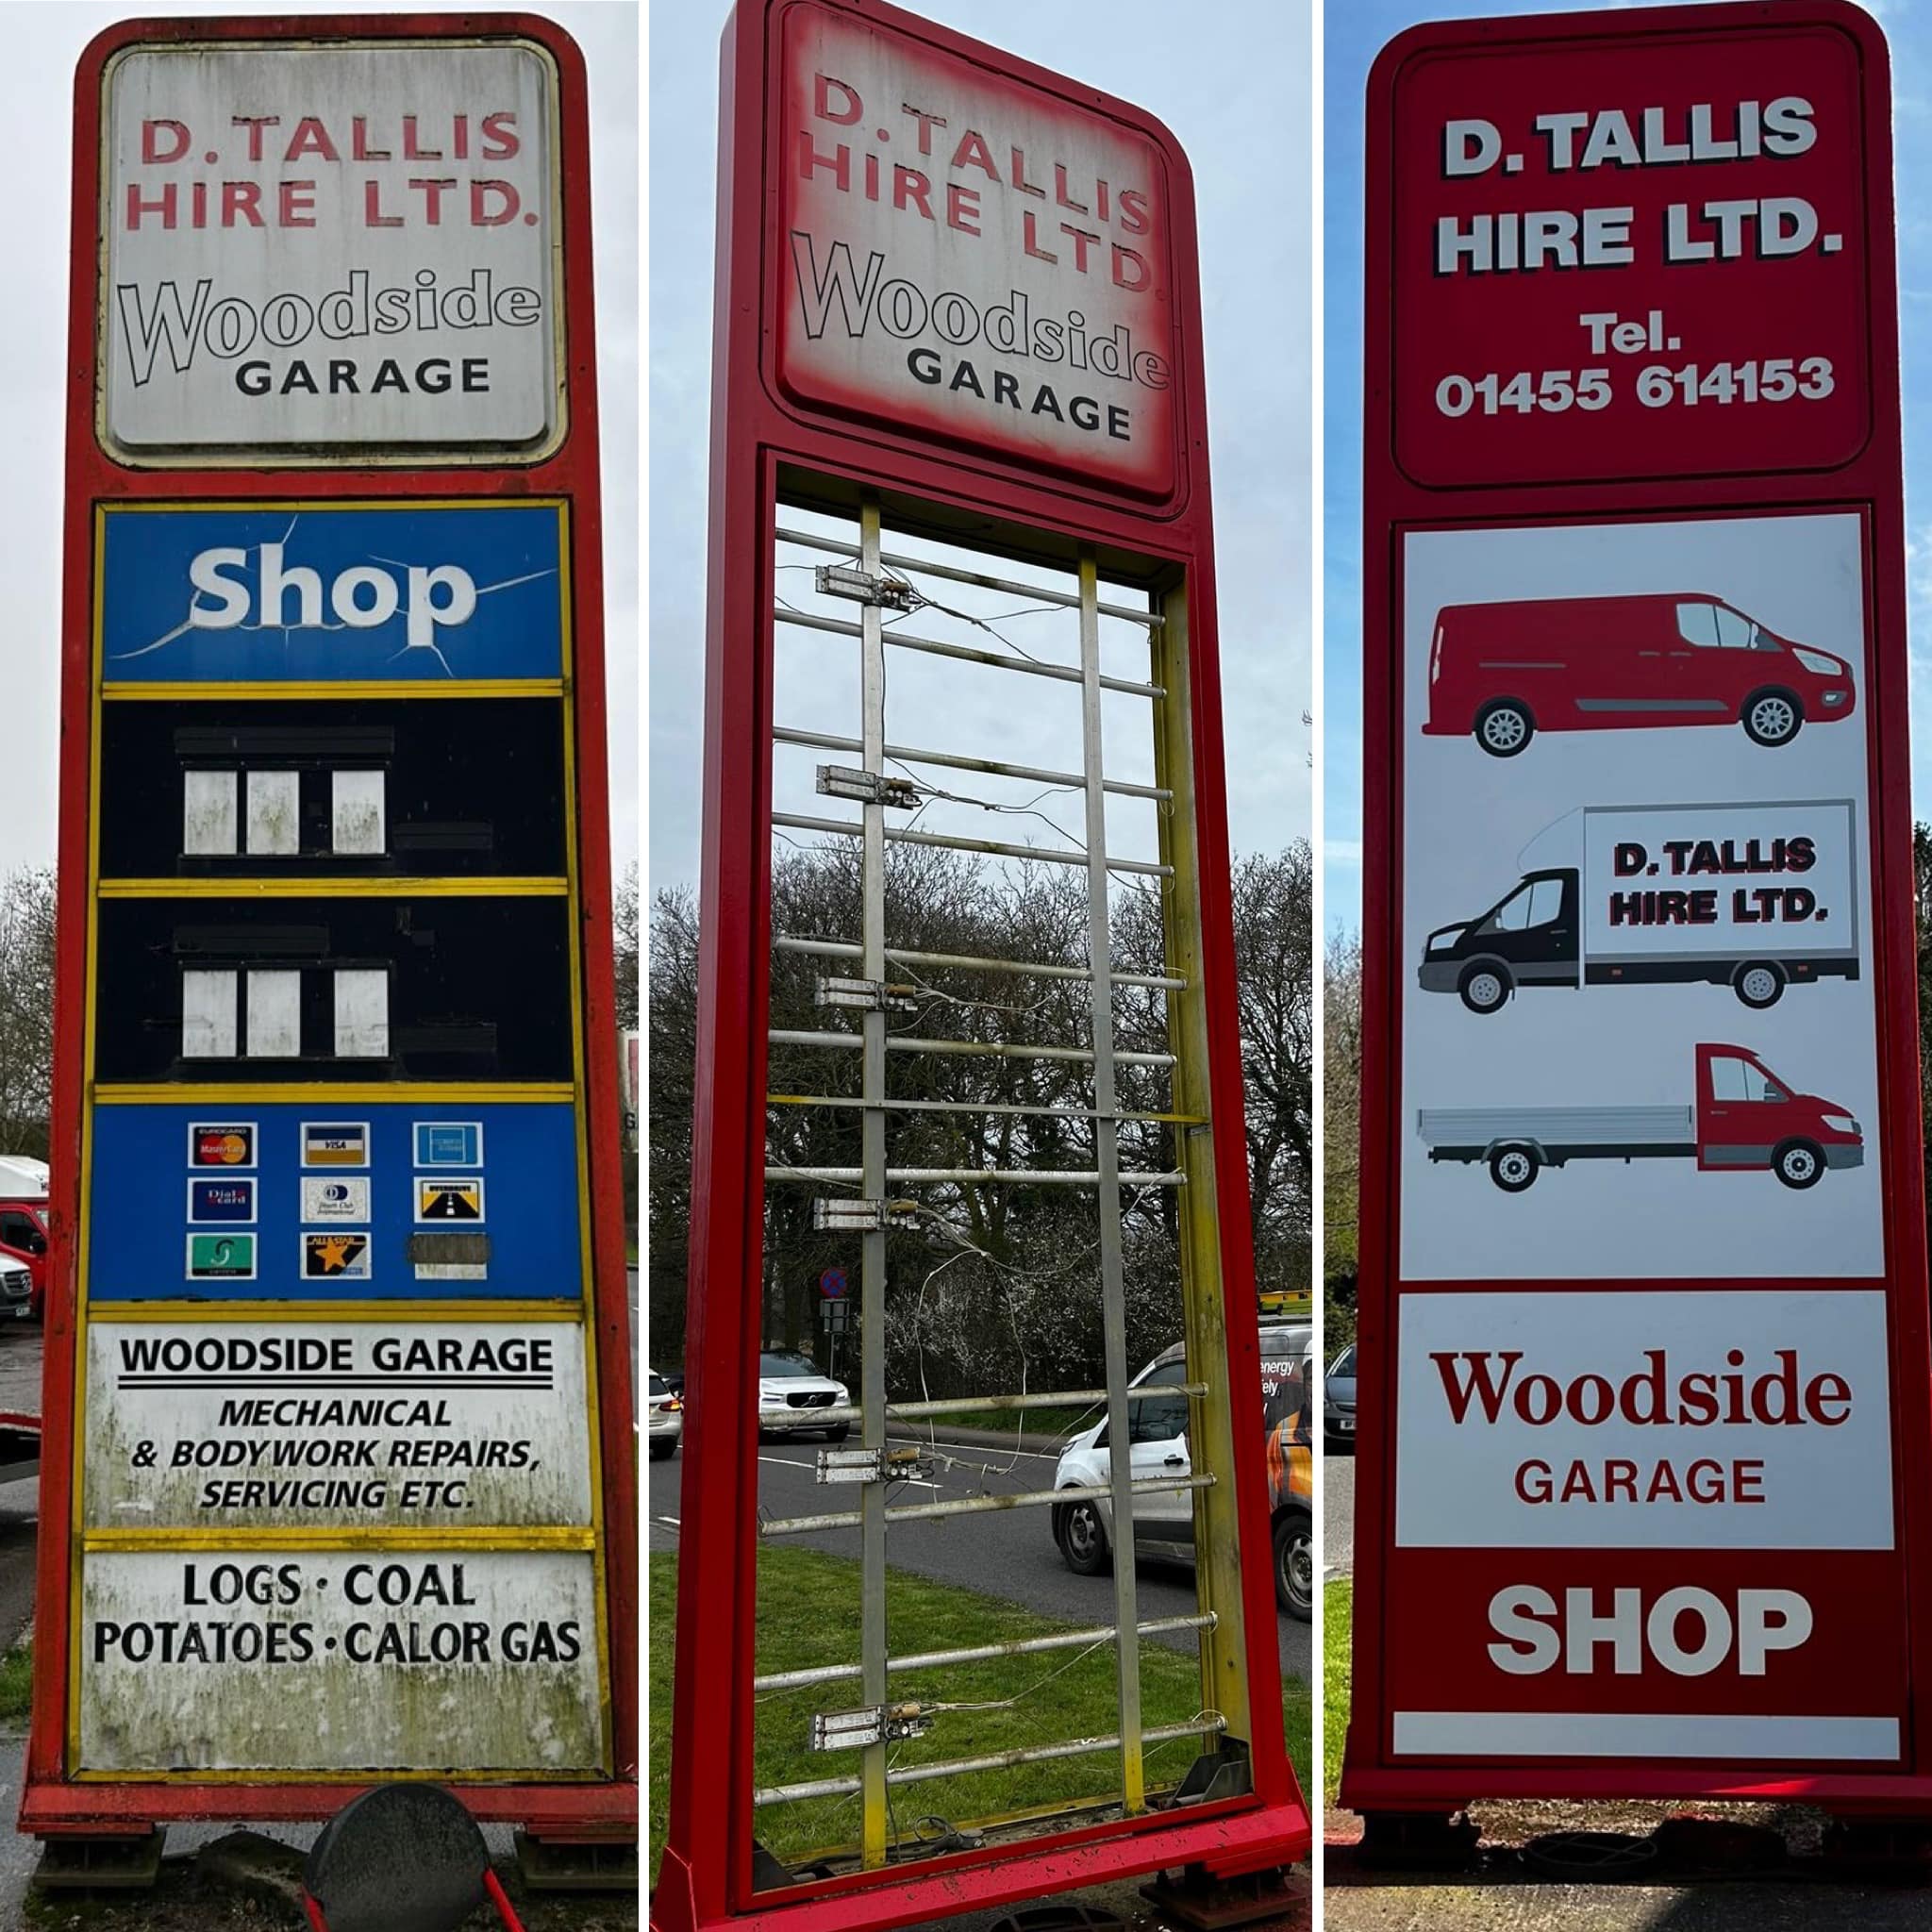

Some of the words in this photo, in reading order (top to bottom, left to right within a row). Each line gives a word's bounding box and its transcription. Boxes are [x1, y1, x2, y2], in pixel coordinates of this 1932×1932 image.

[232, 112, 521, 161] TALLIS
[1442, 120, 1524, 178] D.
[1534, 96, 1818, 174] TALLIS
[800, 132, 981, 237] HIRE
[902, 103, 1150, 236] TALLIS
[126, 179, 317, 231] HIRE
[366, 178, 539, 227] LTD.
[1435, 206, 1634, 275] HIRE
[1664, 197, 1843, 265] LTD.
[117, 269, 541, 388] Woodside
[791, 230, 1171, 391] Woodside
[1579, 310, 1681, 355] Tel.
[236, 358, 490, 396] GARAGE
[908, 348, 1130, 441] GARAGE
[1435, 369, 1612, 418] 01455
[1637, 357, 1835, 408] 614153
[190, 543, 476, 646] Shop
[1614, 842, 1658, 876] D.
[1663, 838, 1816, 875] TALLIS
[1610, 889, 1718, 926] HIRE
[1732, 886, 1828, 923] LTD.
[121, 1339, 353, 1373] WOODSIDE
[373, 1338, 554, 1373] GARAGE
[1429, 1349, 1852, 1426] Woodside
[219, 1400, 452, 1427] MECHANICAL
[131, 1441, 158, 1467] &
[171, 1440, 377, 1468] BODYWORK
[388, 1440, 541, 1472] REPAIRS,
[1514, 1459, 1766, 1504] GARAGE
[201, 1481, 385, 1508] SERVICING
[400, 1481, 475, 1508] ETC.
[183, 1565, 301, 1606] LOGS
[344, 1565, 475, 1606] COAL
[95, 1622, 313, 1664] POTATOES
[344, 1622, 491, 1663] CALOR
[501, 1622, 580, 1663] GAS
[1487, 1584, 1813, 1676] SHOP
